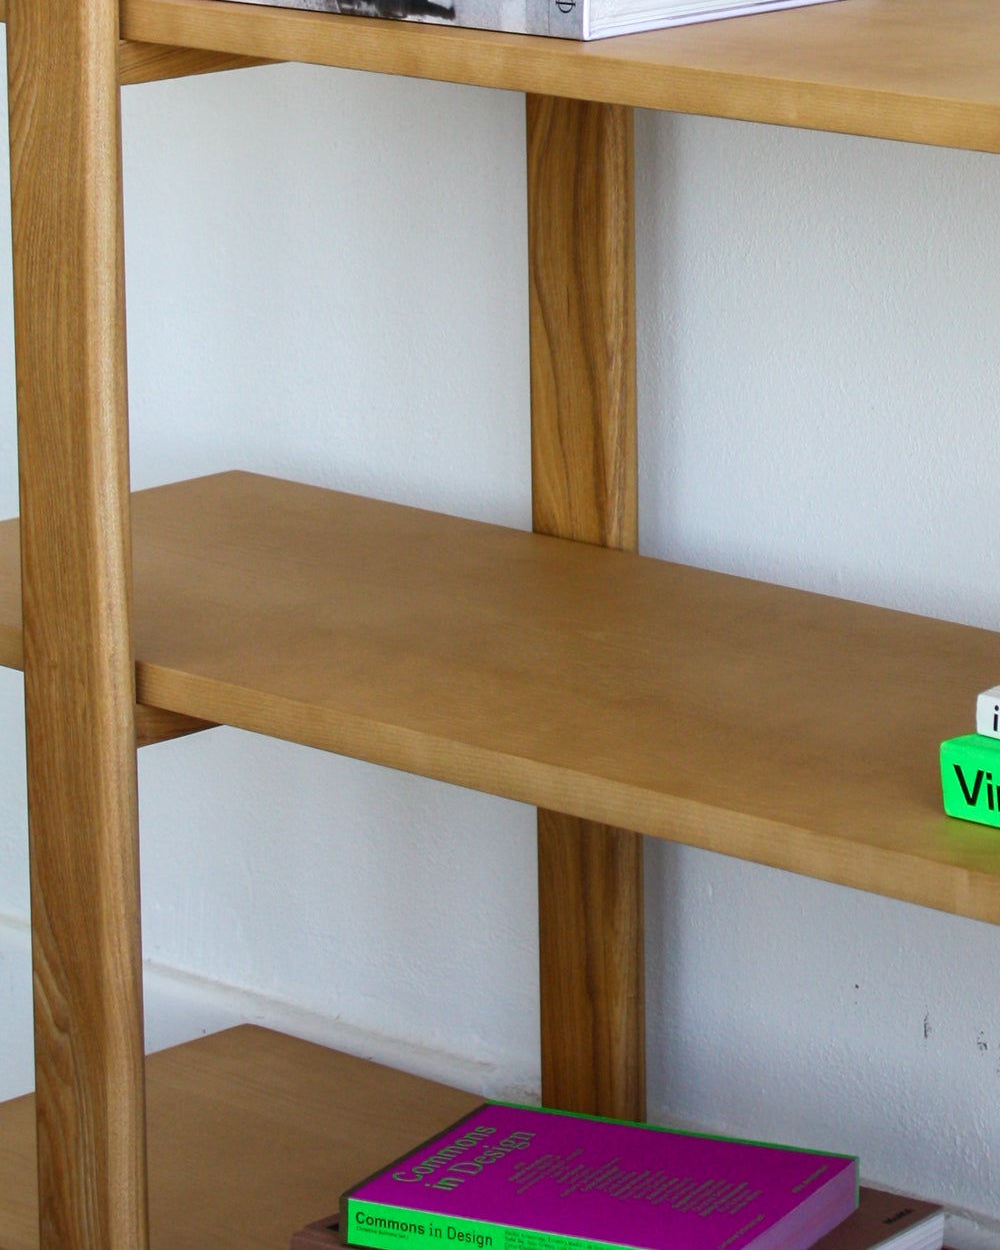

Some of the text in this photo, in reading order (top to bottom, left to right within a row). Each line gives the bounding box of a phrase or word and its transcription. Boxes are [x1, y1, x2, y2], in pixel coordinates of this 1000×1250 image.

[392, 1126, 497, 1182] Commons
[424, 1131, 537, 1191] in Design
[355, 1211, 425, 1235] Commons
[429, 1223, 442, 1239] in
[447, 1226, 493, 1248] Design
